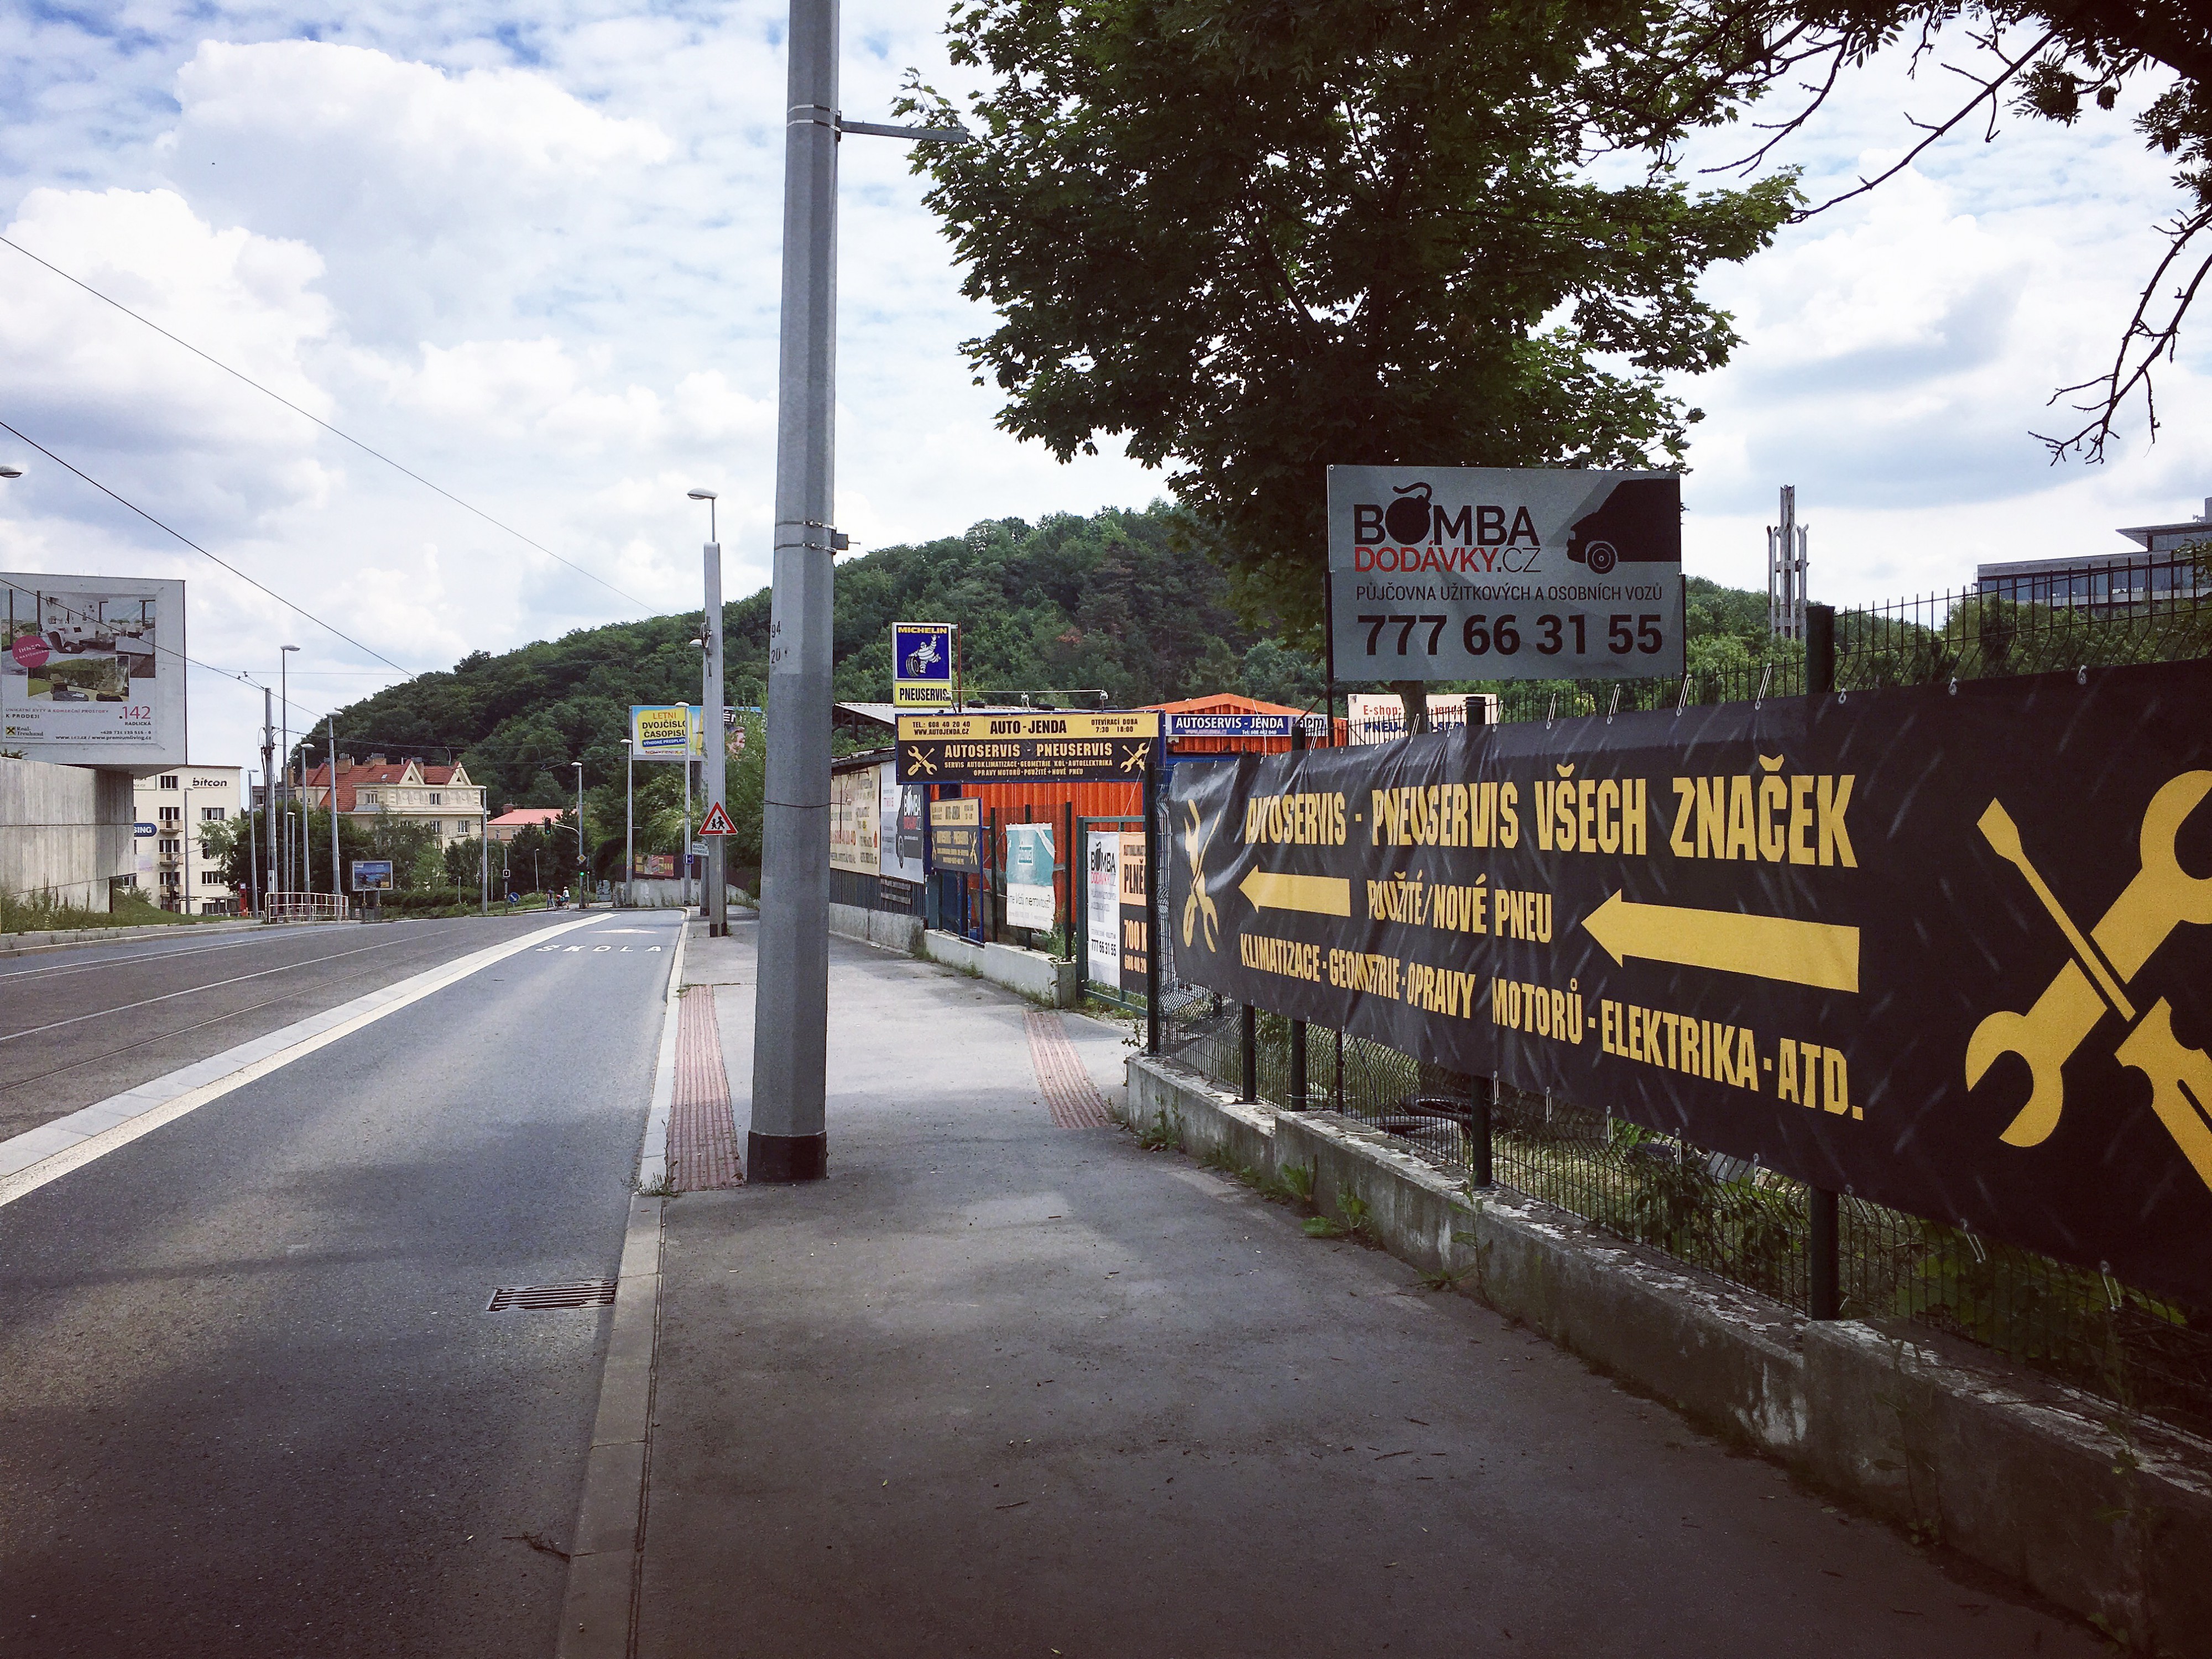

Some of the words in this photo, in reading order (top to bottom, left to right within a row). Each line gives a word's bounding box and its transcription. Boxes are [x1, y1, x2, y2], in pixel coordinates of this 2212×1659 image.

[1354, 540, 1542, 573] DODÁVKY.CZ
[1357, 582, 1436, 601] PŮJČOVNA
[1441, 582, 1530, 601] UŽITKOVÝCH
[1535, 587, 1544, 601] A
[1548, 582, 1621, 601] OSOBNÍCH
[1626, 582, 1662, 601] VOZŮ
[1357, 614, 1447, 656] 777
[1463, 614, 1521, 656] 66
[1536, 614, 1585, 656] 31
[1608, 614, 1662, 656] 55
[899, 687, 947, 701] PNEUSERVIS
[1363, 705, 1402, 717] E-shop:
[1091, 717, 1120, 726] OTEVÍRACÍ
[1176, 717, 1241, 729] AUTOSERVIS
[1250, 717, 1284, 729] JENDA
[944, 744, 1020, 758] AUTOSERVIS
[1036, 743, 1113, 757] PNEUSERVIS
[192, 778, 227, 787] bitcon
[1245, 791, 1347, 845] AUTOSERVIS
[1372, 781, 1519, 848] PNEUSERVIS
[1534, 763, 1647, 855] VŠECH
[1670, 754, 1858, 868] ZNAČEK
[1124, 859, 1146, 895] PLNĚ
[1494, 889, 1552, 943] PNEU
[1124, 919, 1140, 951] 700
[535, 944, 662, 952] ŠKOLA
[1099, 941, 1104, 953] 66
[1105, 942, 1110, 955] 31
[1111, 943, 1117, 957] 55
